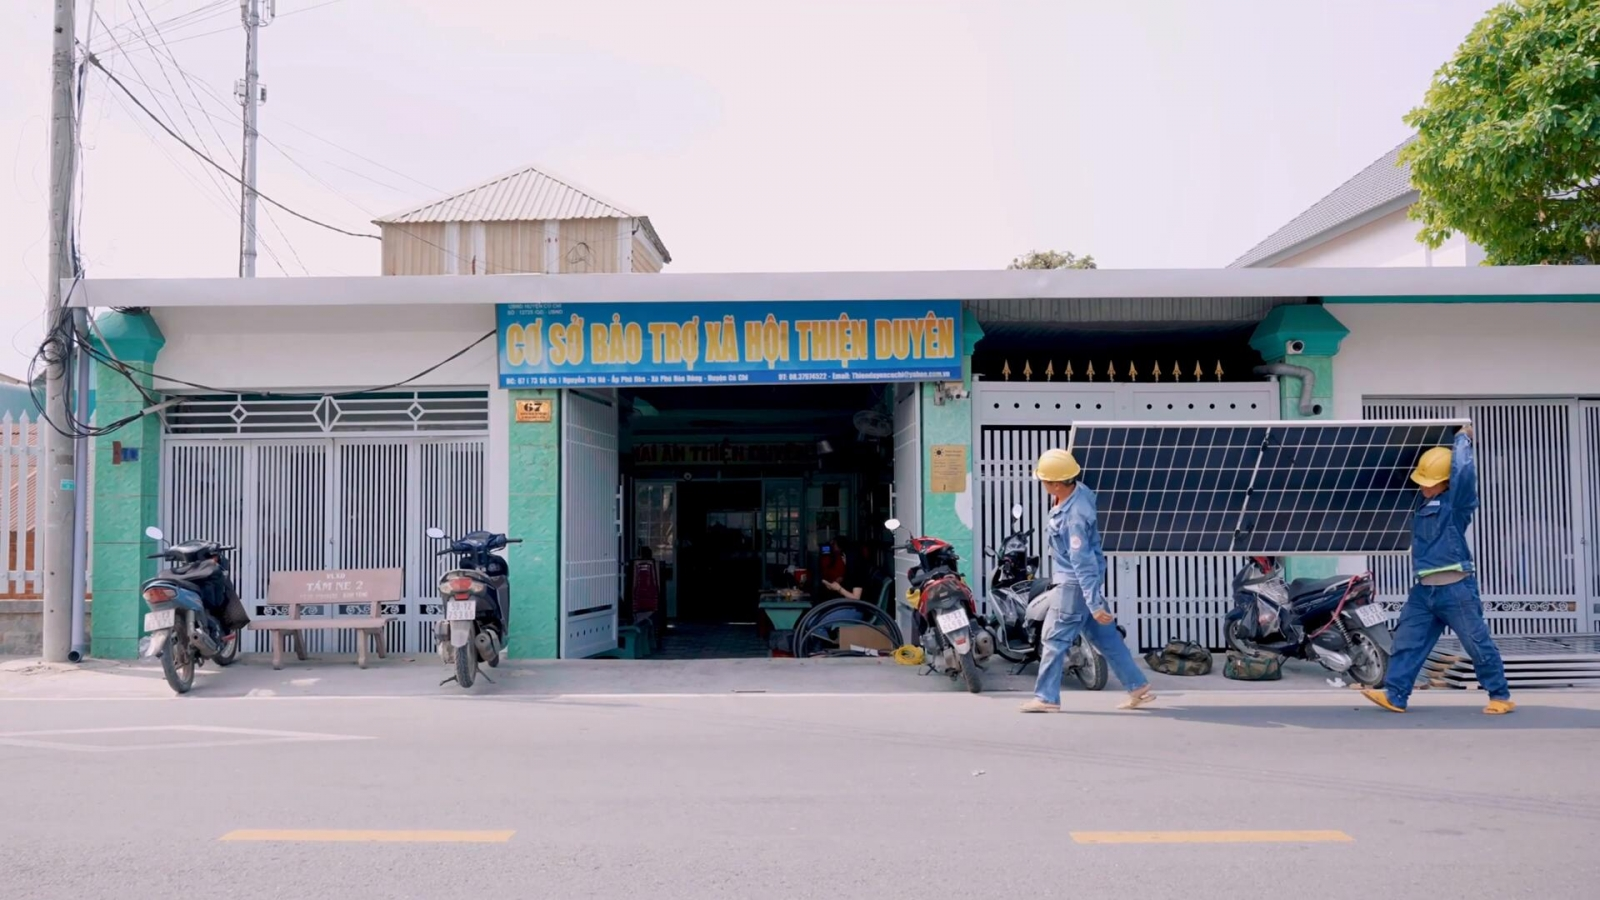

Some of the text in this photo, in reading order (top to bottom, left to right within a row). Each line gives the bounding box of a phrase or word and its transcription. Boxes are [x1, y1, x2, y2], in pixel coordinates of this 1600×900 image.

[506, 311, 954, 371] CƠ SỞ BẢO TRỢ XÃ HỘI THIỆN DUYÊN
[524, 403, 542, 411] 67
[306, 580, 332, 592] TÁM
[355, 580, 364, 590] 2
